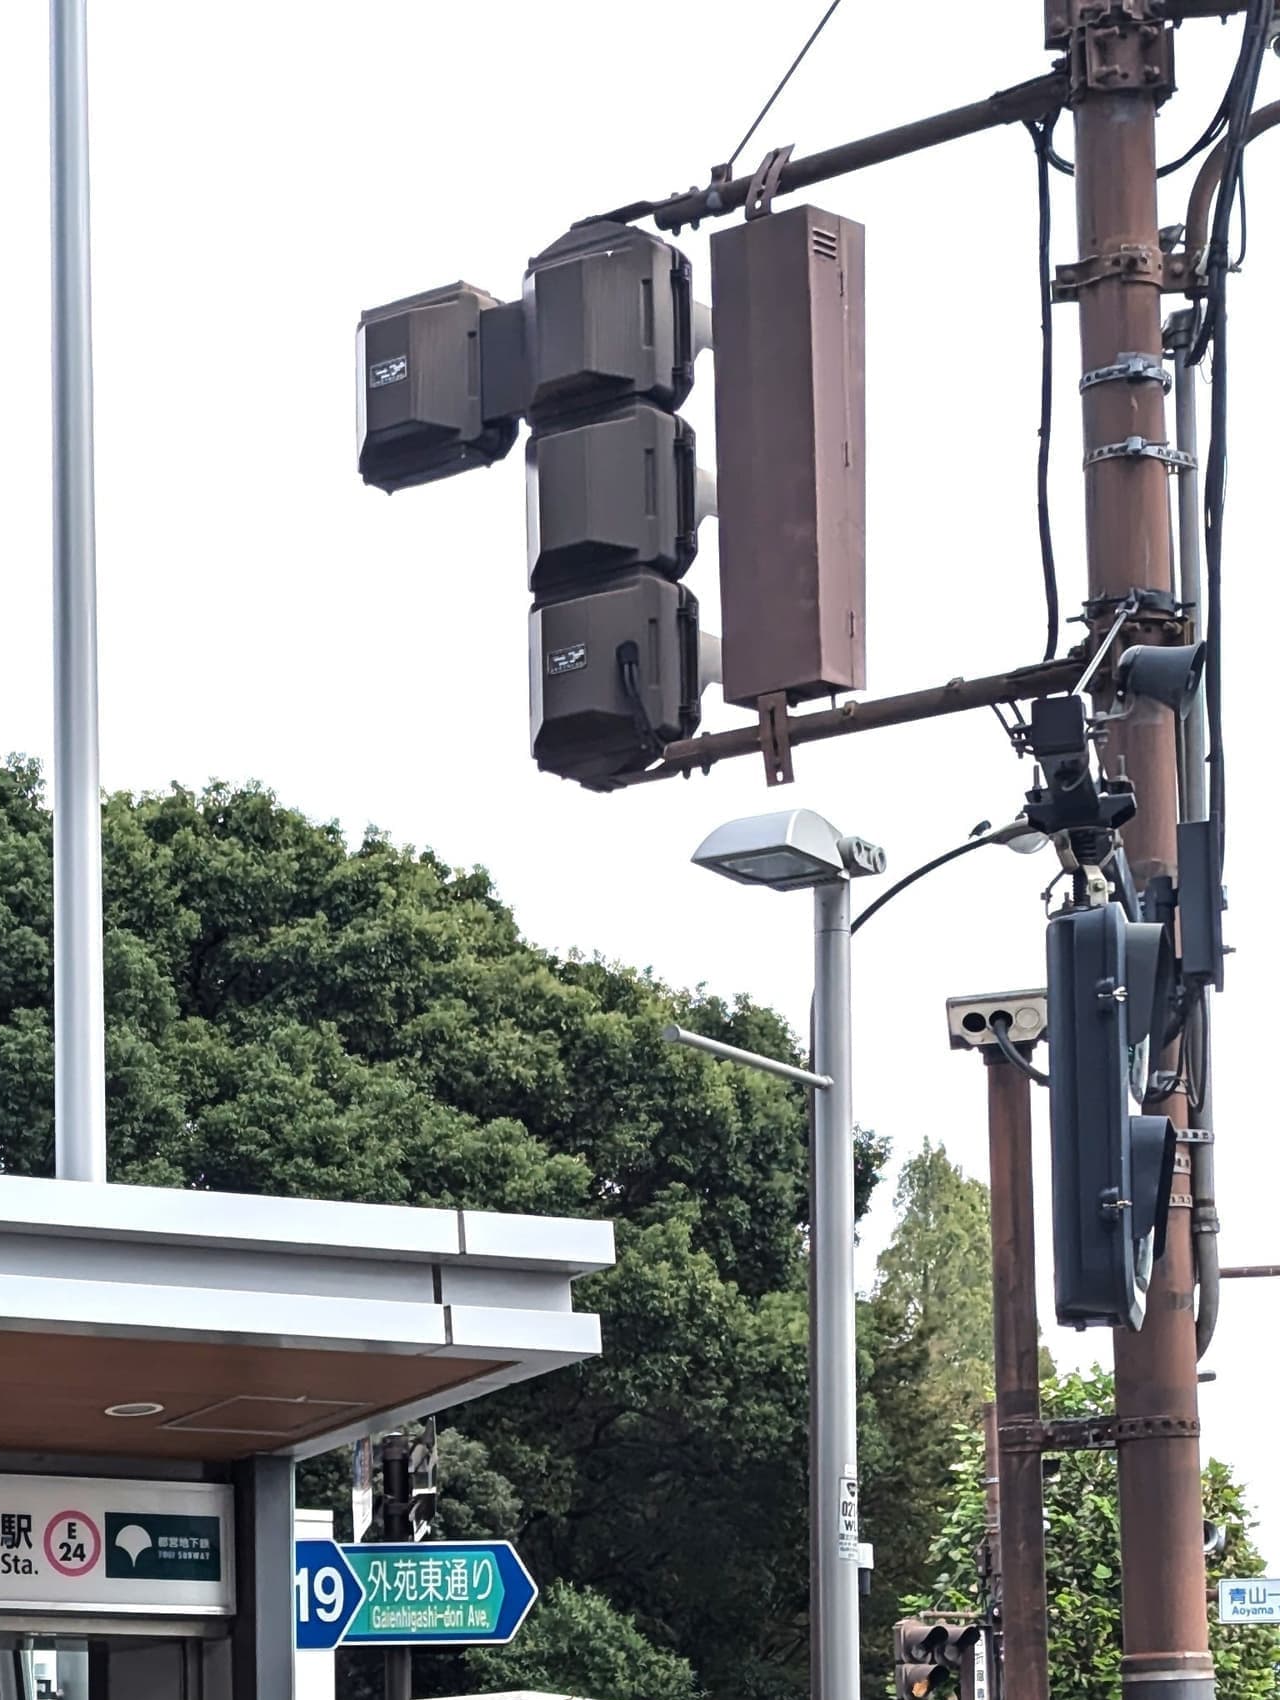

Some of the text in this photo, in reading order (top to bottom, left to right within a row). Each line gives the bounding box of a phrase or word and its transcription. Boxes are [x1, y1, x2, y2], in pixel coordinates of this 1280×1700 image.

[67, 1522, 77, 1540] E
[58, 1542, 86, 1563] 24
[1, 1552, 39, 1576] Sta.
[367, 1558, 493, 1603] 外苑東通り
[372, 1605, 464, 1632] Gaienhigashi-dori
[1232, 1606, 1274, 1617] Aoyama
